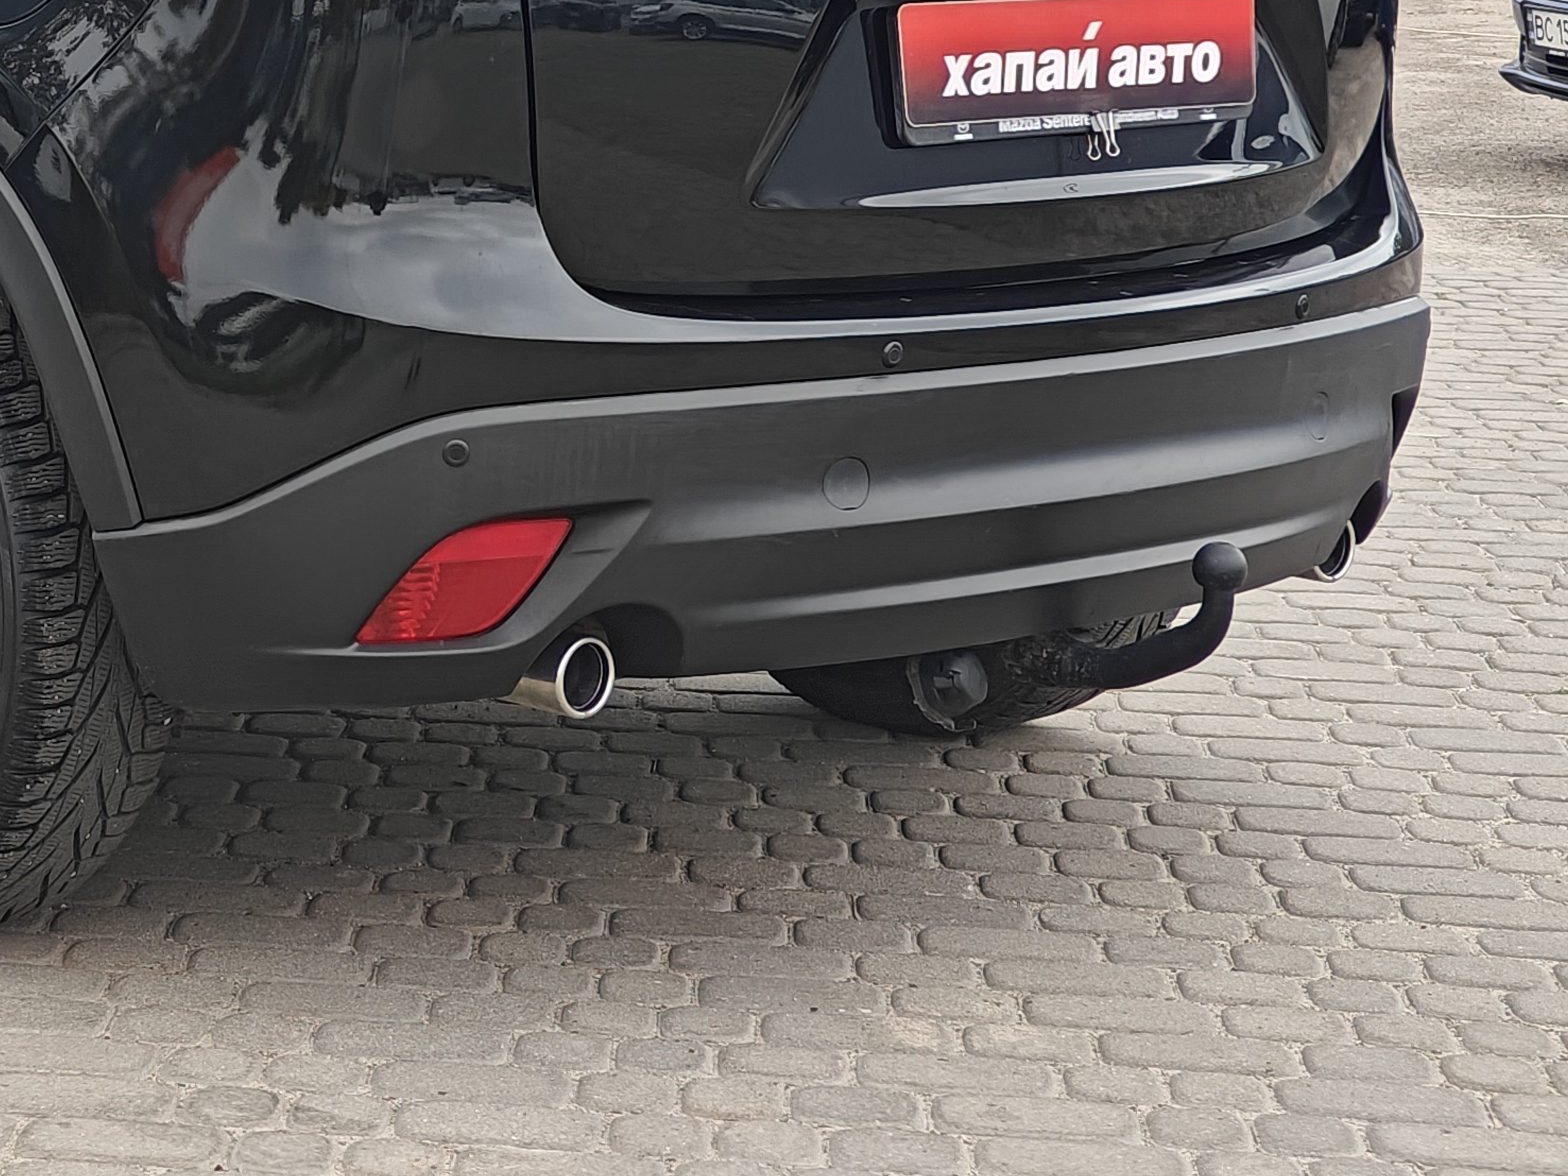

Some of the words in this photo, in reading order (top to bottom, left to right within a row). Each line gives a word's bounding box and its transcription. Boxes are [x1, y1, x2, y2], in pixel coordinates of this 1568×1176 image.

[1535, 14, 1554, 43] BC
[1107, 40, 1221, 87] авто
[998, 118, 1042, 133] Mazda
